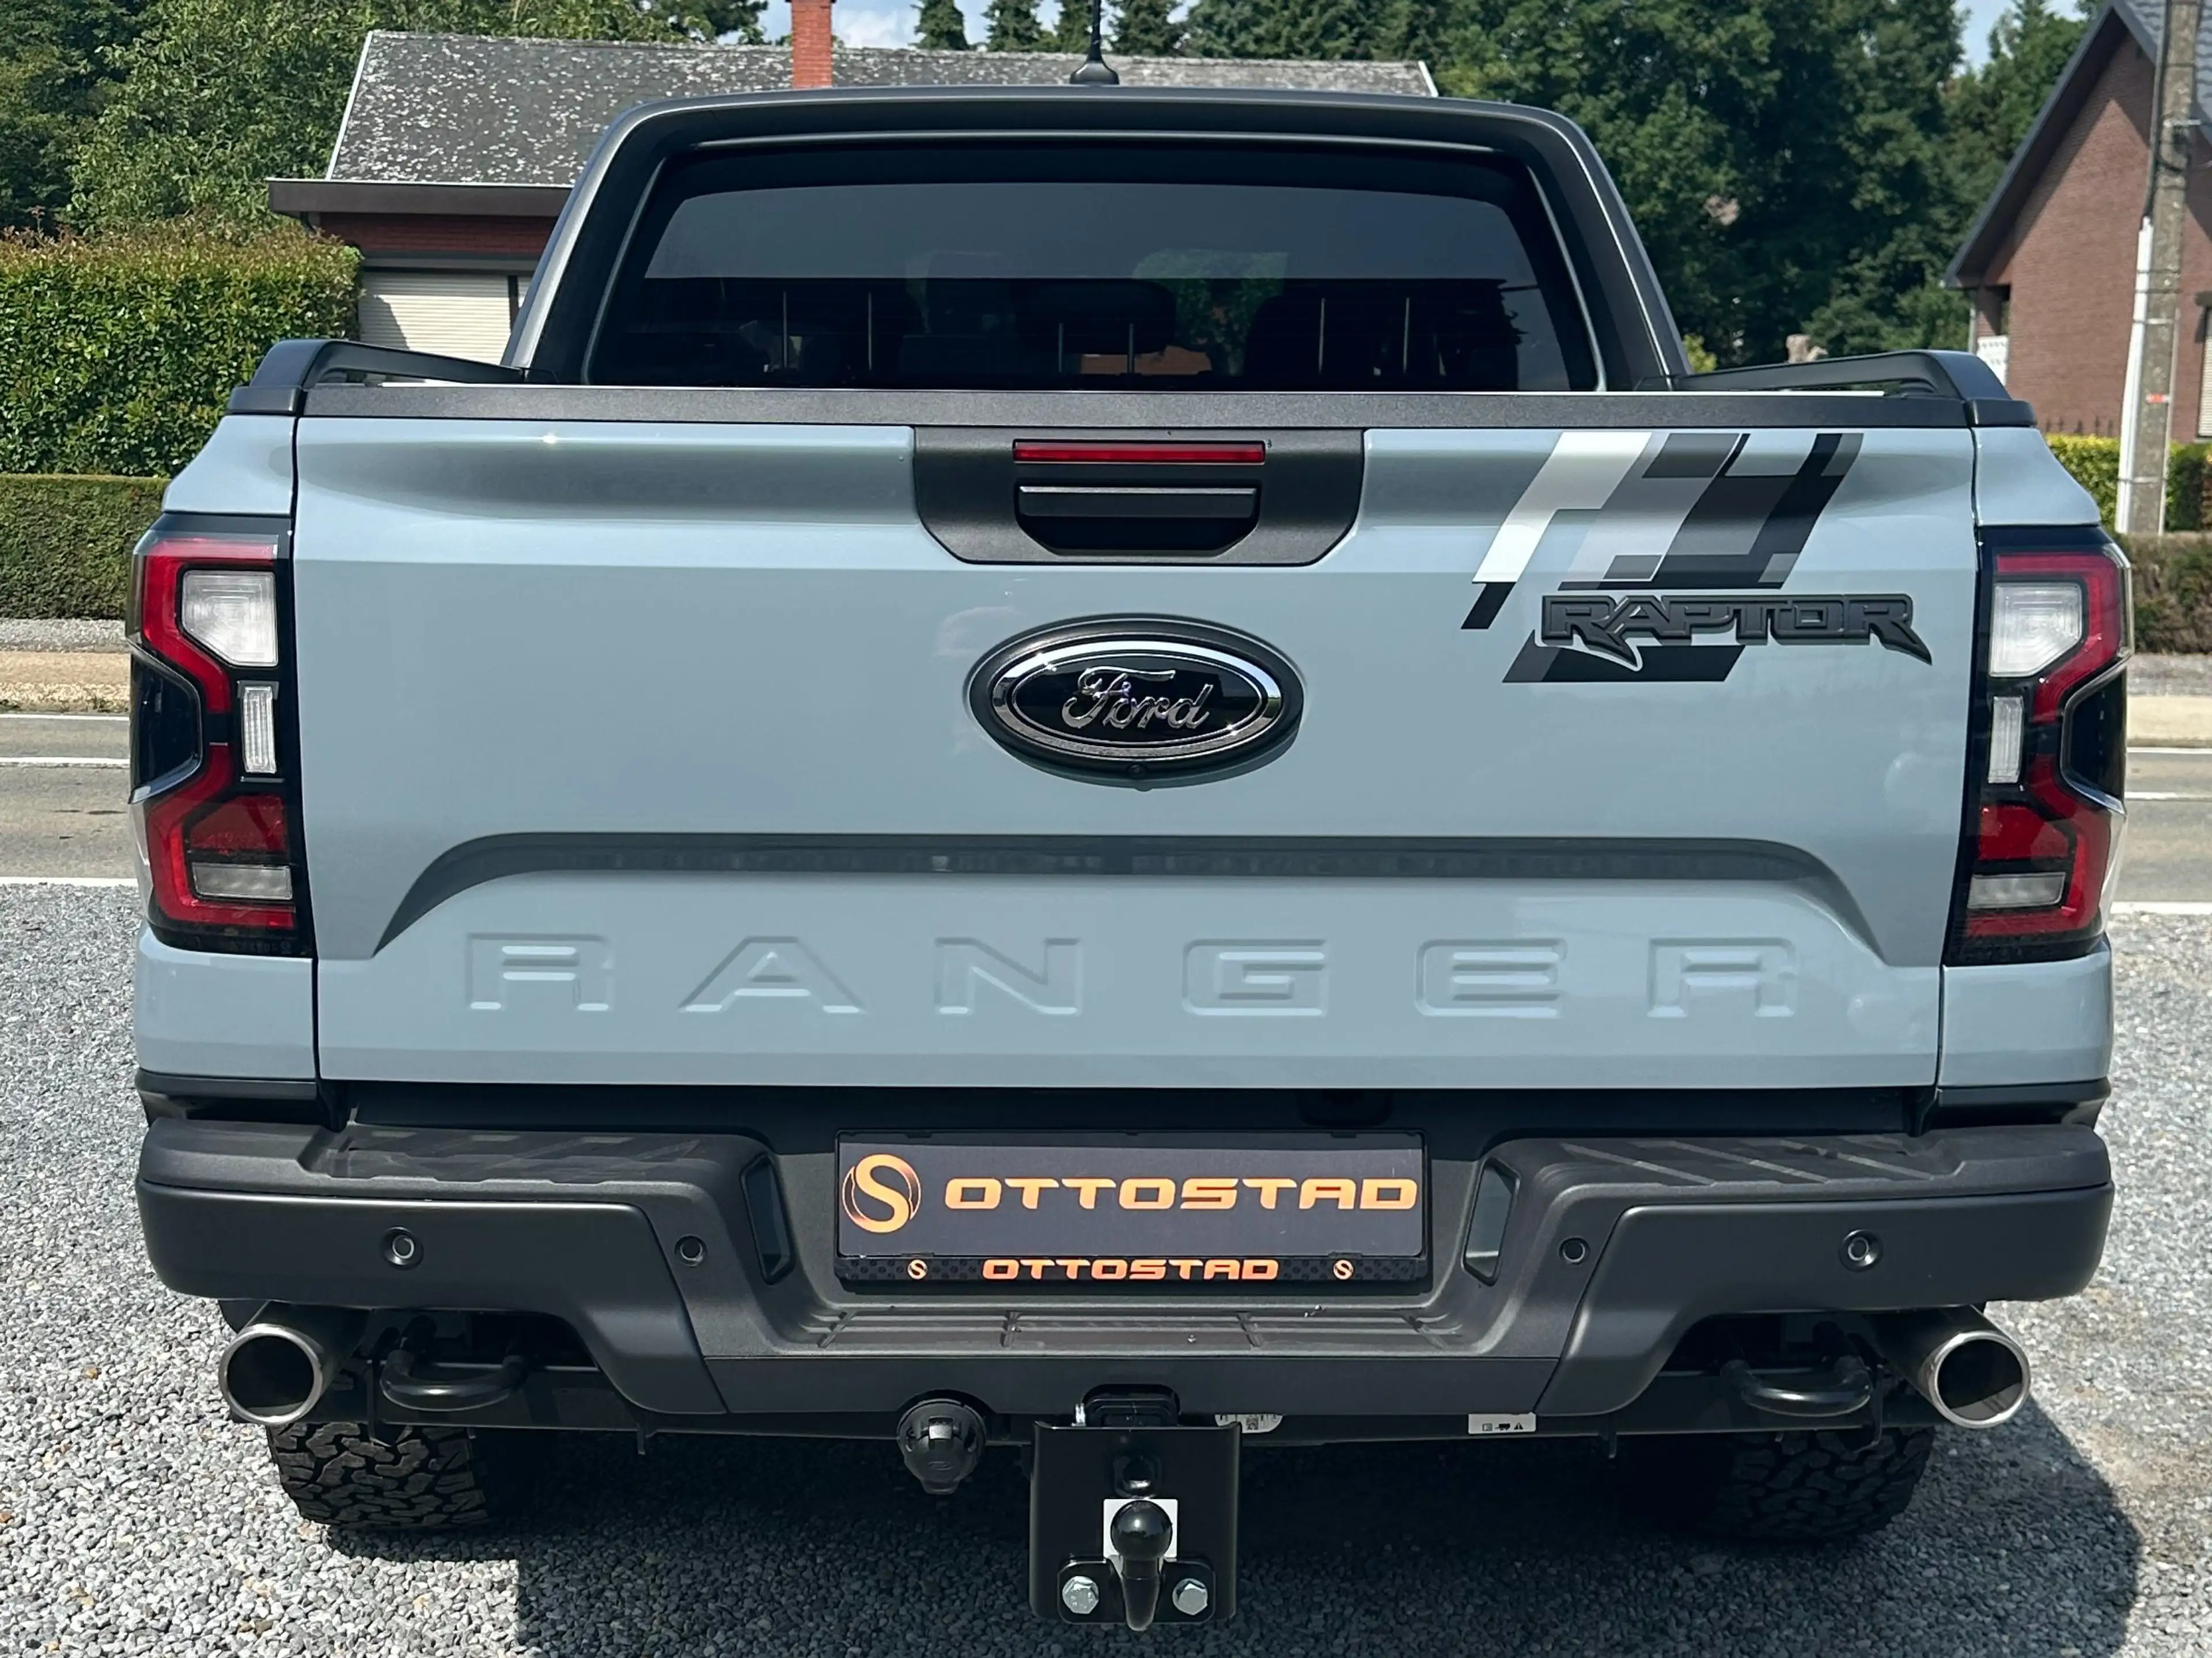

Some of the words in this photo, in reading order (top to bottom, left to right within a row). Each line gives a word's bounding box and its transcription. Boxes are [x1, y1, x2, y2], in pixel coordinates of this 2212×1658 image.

[1542, 594, 1932, 670] RAPTOR
[1062, 666, 1213, 729] Ford
[467, 934, 1797, 1017] RANGER
[945, 1177, 1418, 1210] OTTOSTAD
[983, 1259, 1278, 1279] OTTOSTAD
